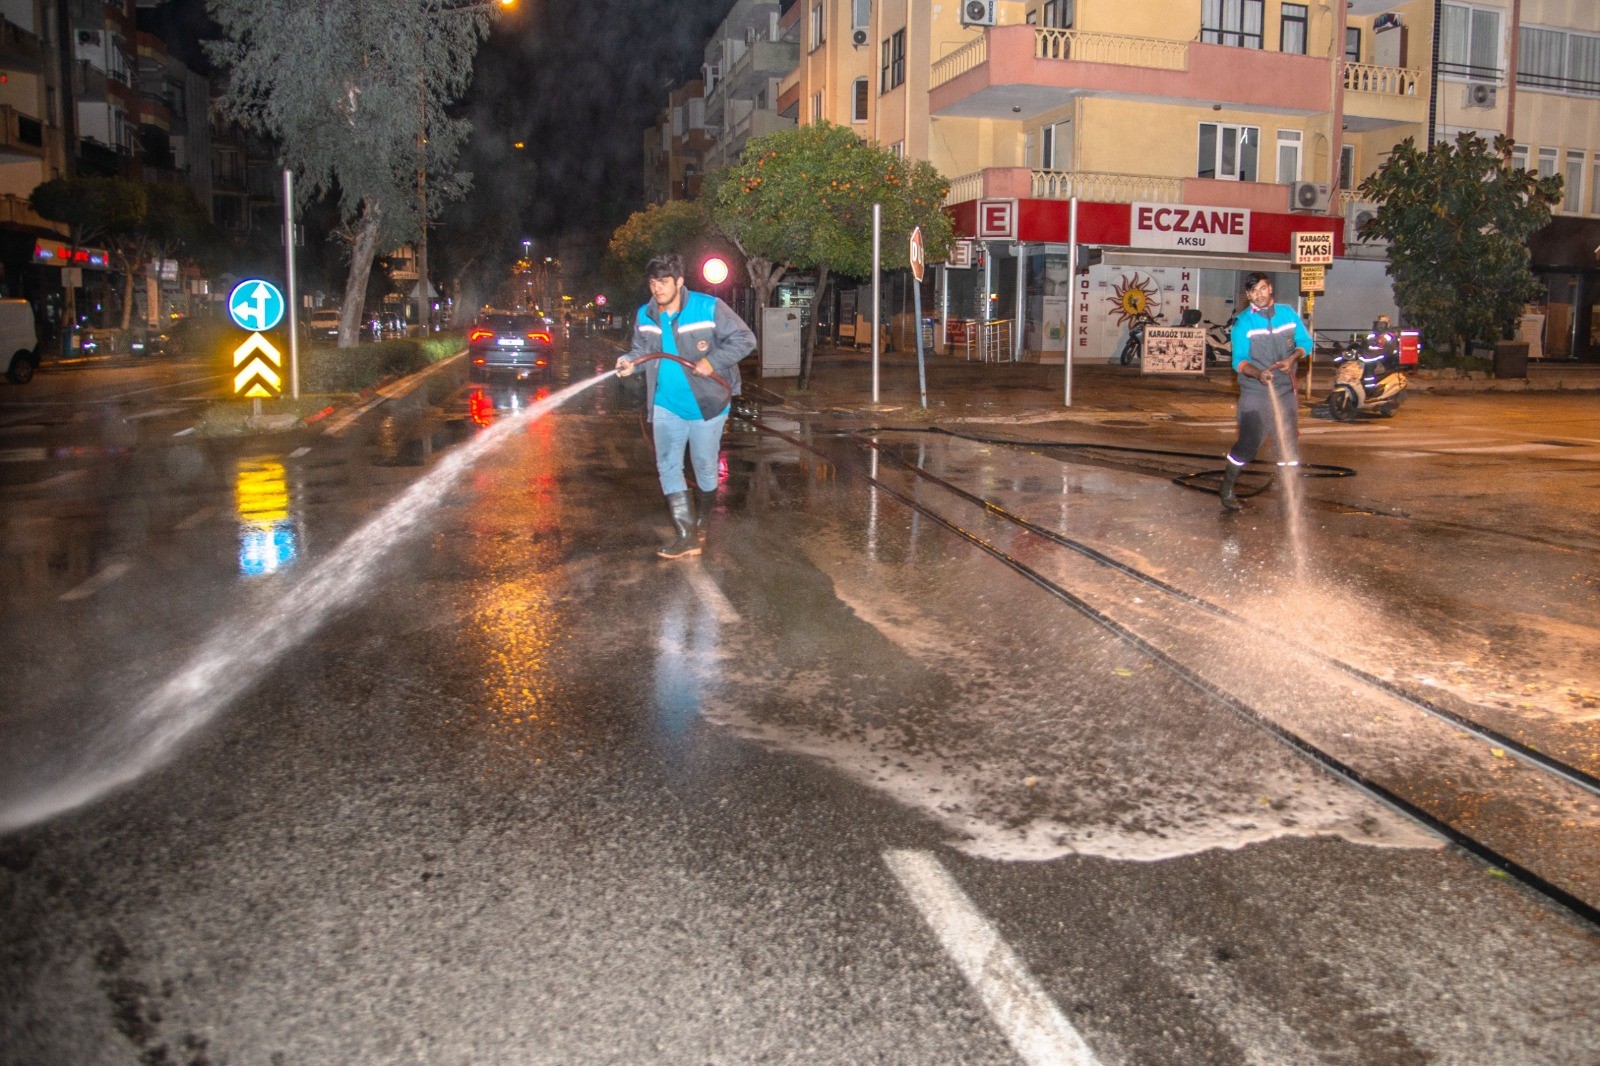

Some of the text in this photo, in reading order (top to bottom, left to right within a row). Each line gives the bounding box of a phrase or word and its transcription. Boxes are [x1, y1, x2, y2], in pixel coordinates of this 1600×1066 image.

[1138, 207, 1244, 235] ECZANE
[1177, 236, 1206, 246] AKSU
[1300, 234, 1330, 242] KARAGÖZ
[1298, 242, 1331, 255] TAKSİ
[1148, 329, 1178, 339] KARAGÖZ
[1179, 330, 1194, 339] TAXI
